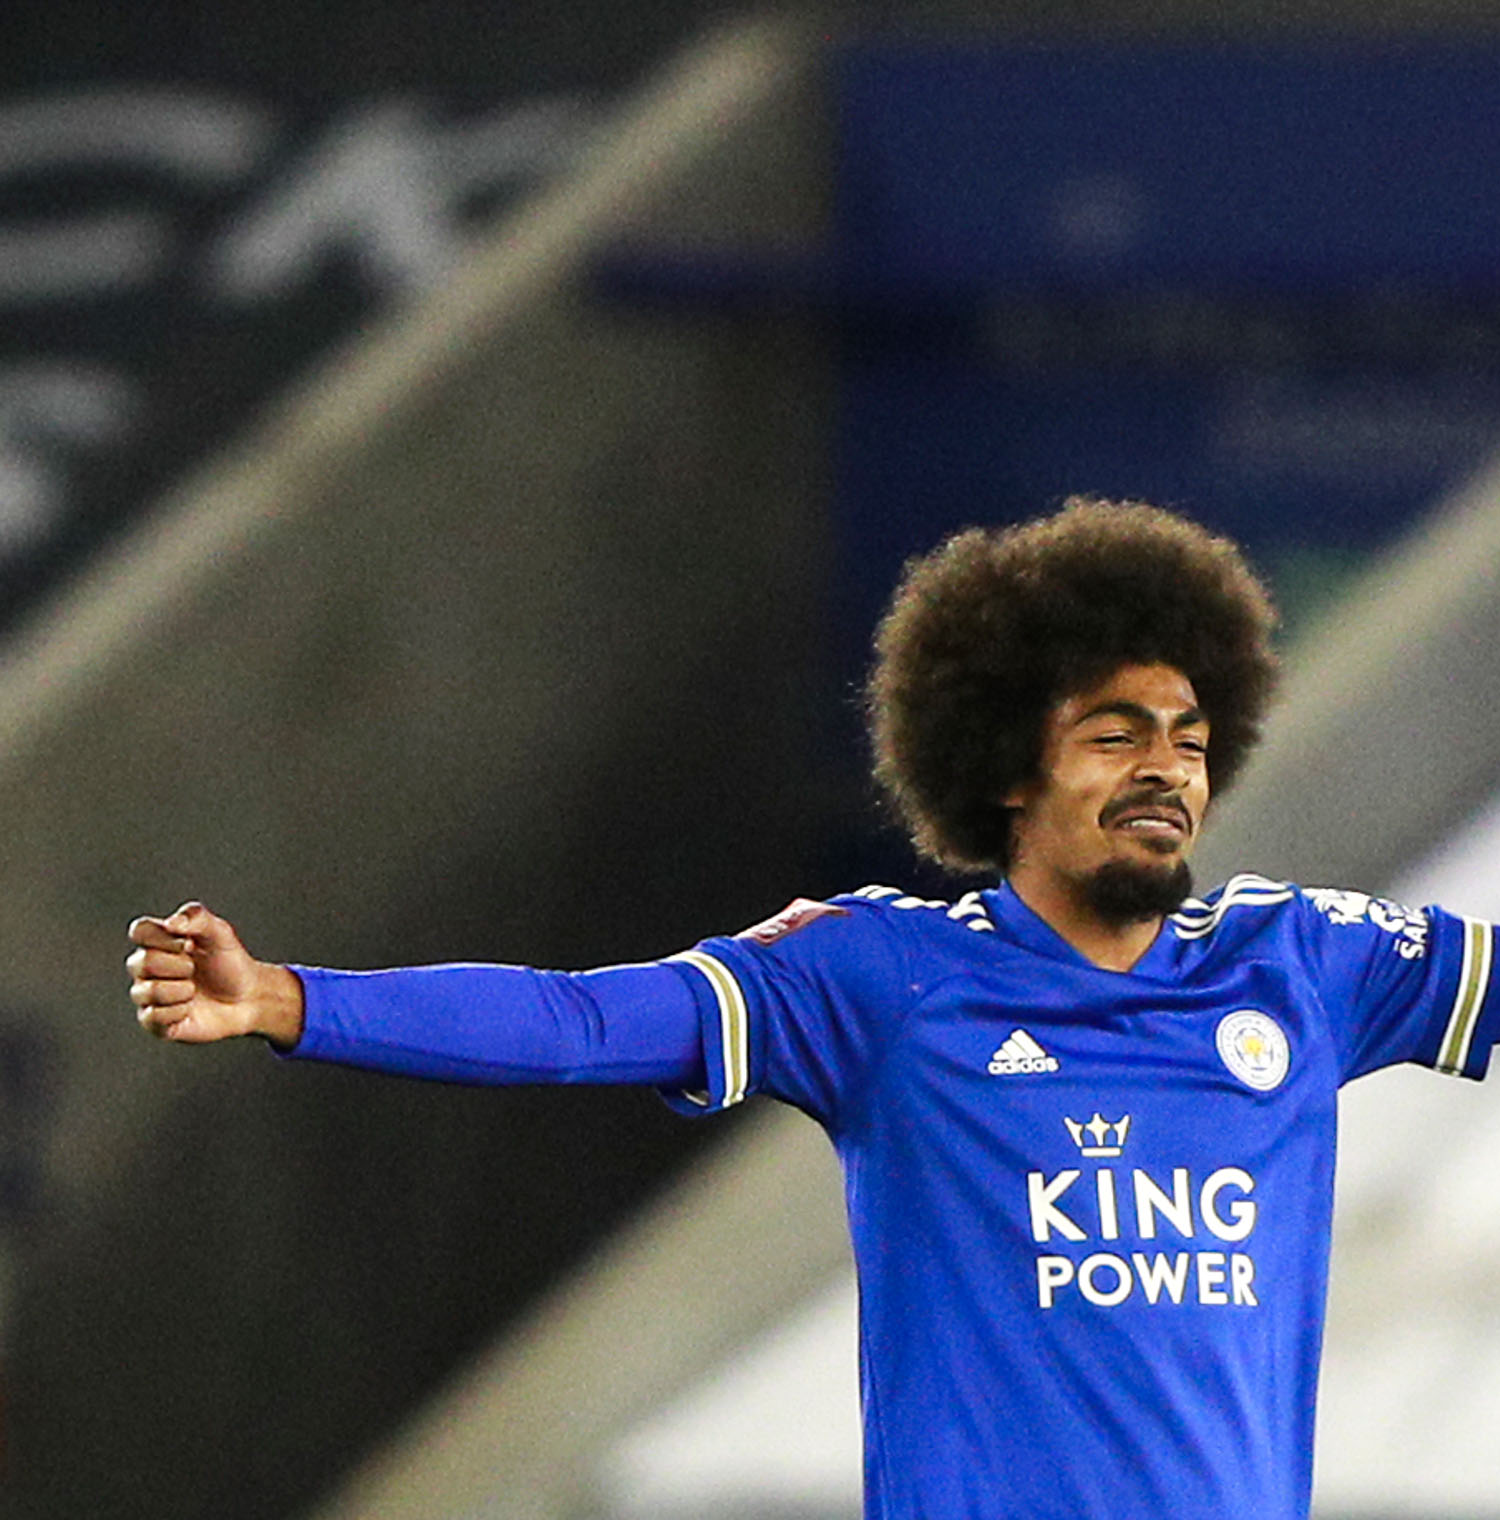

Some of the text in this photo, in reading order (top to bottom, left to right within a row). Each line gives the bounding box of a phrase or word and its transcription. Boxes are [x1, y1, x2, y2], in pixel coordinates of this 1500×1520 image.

[987, 1057, 1060, 1075] adidas
[1027, 1167, 1257, 1242] KING
[1037, 1252, 1258, 1308] POWER
